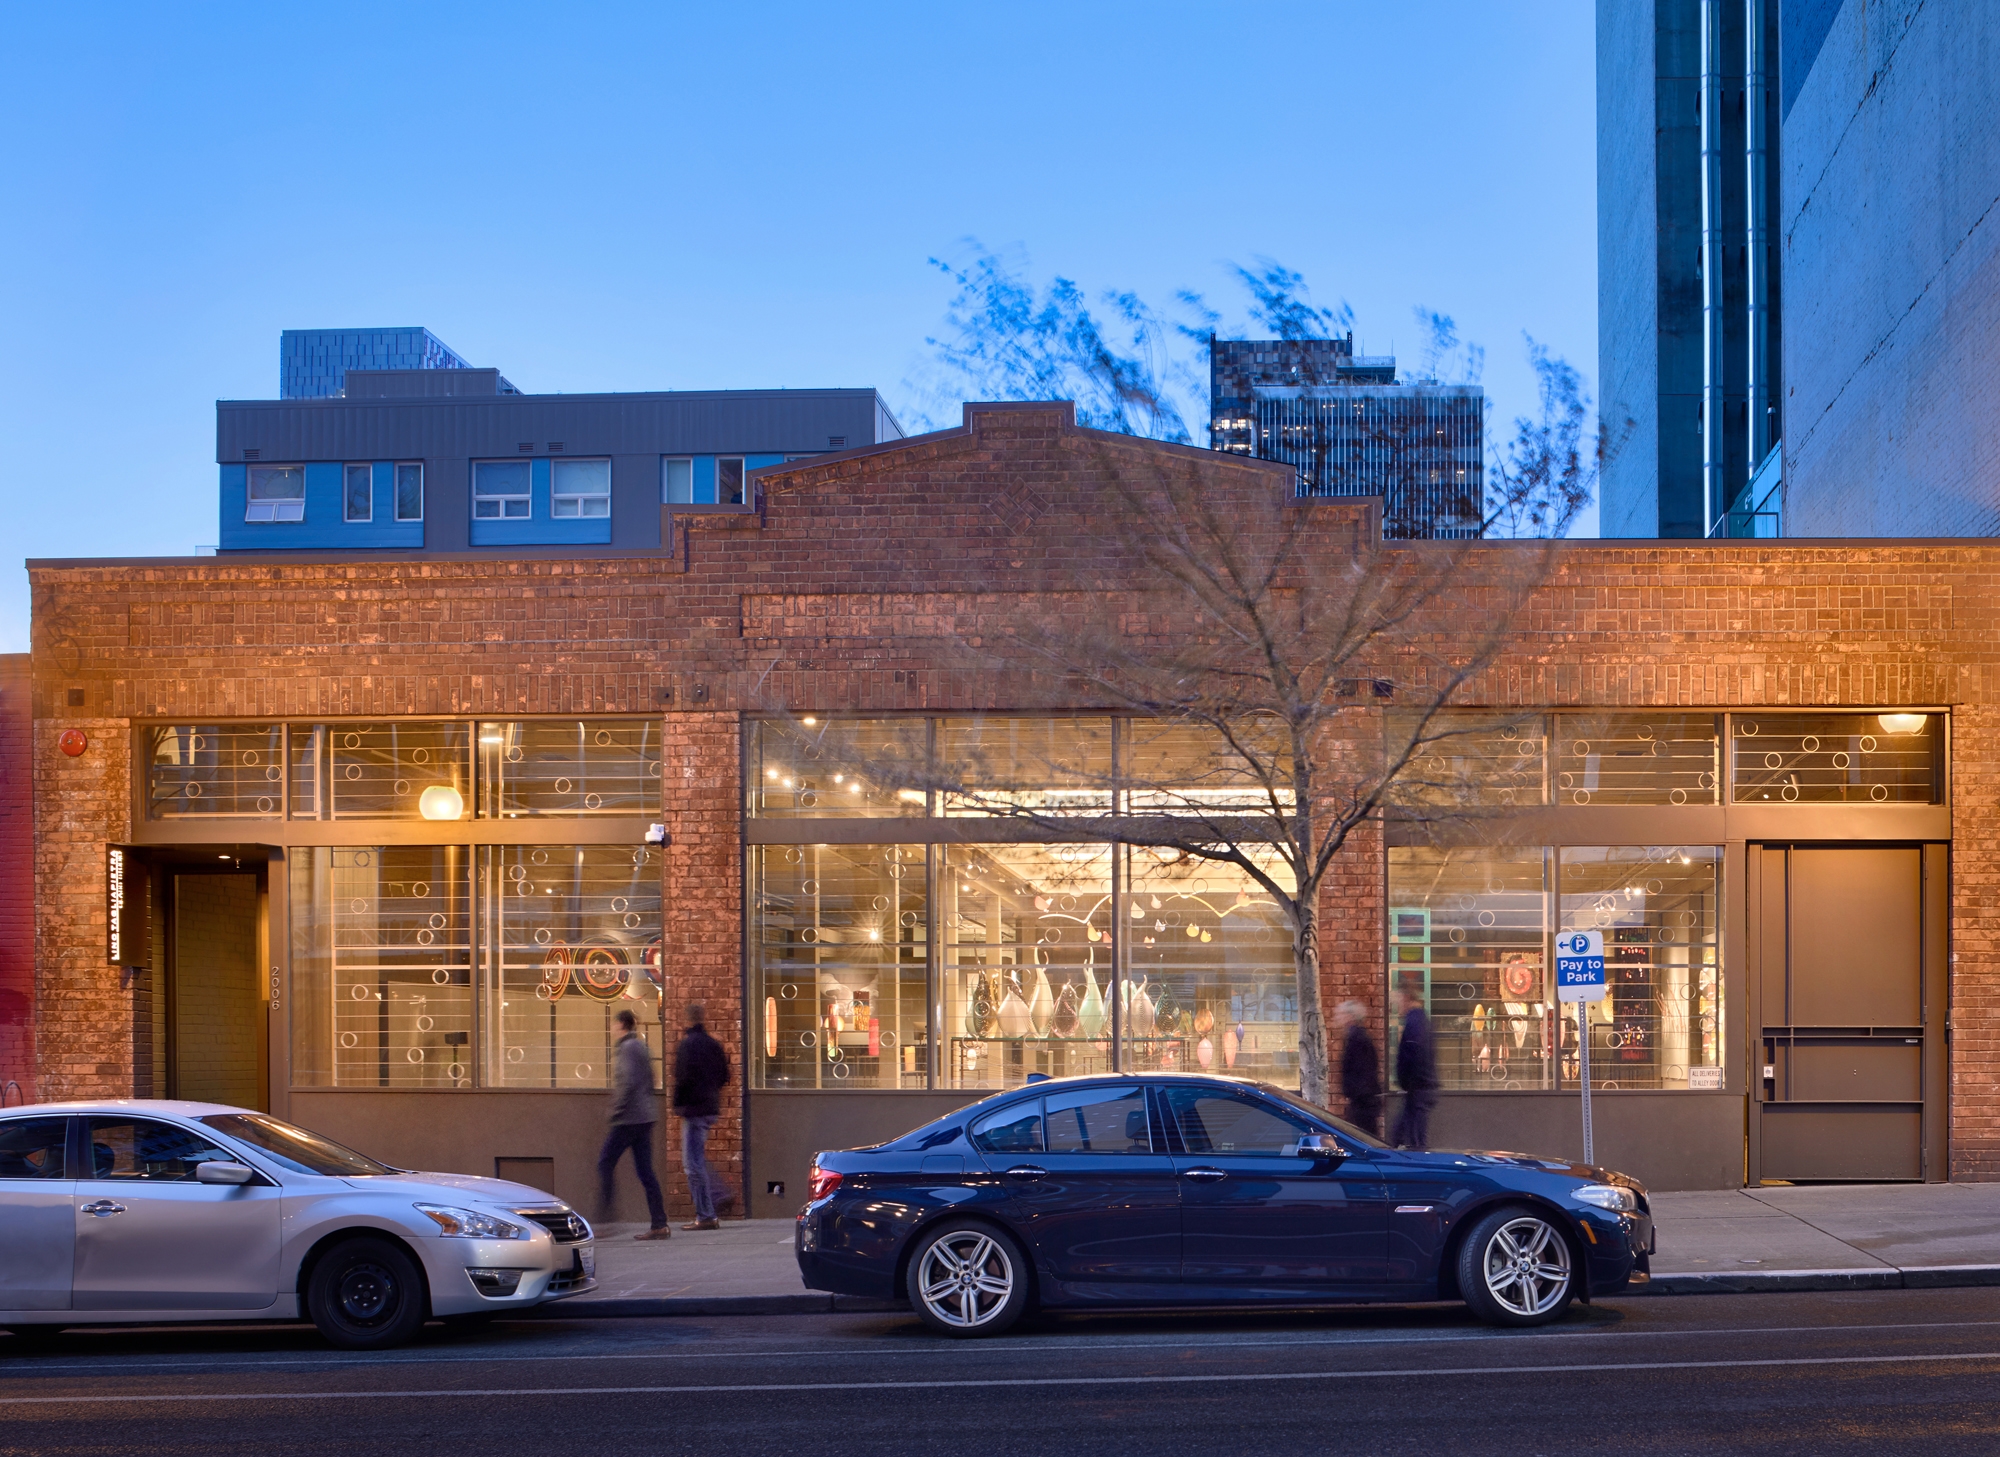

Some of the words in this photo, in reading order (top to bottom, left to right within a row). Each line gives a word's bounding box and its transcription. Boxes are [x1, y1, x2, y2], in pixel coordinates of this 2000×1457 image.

[110, 850, 119, 931] TAGLIAPIETRA
[110, 933, 119, 960] LINO
[1575, 938, 1586, 951] P
[1560, 960, 1583, 972] Pay
[1587, 959, 1602, 969] to
[1566, 971, 1596, 983] Park
[271, 966, 280, 1010] 2006
